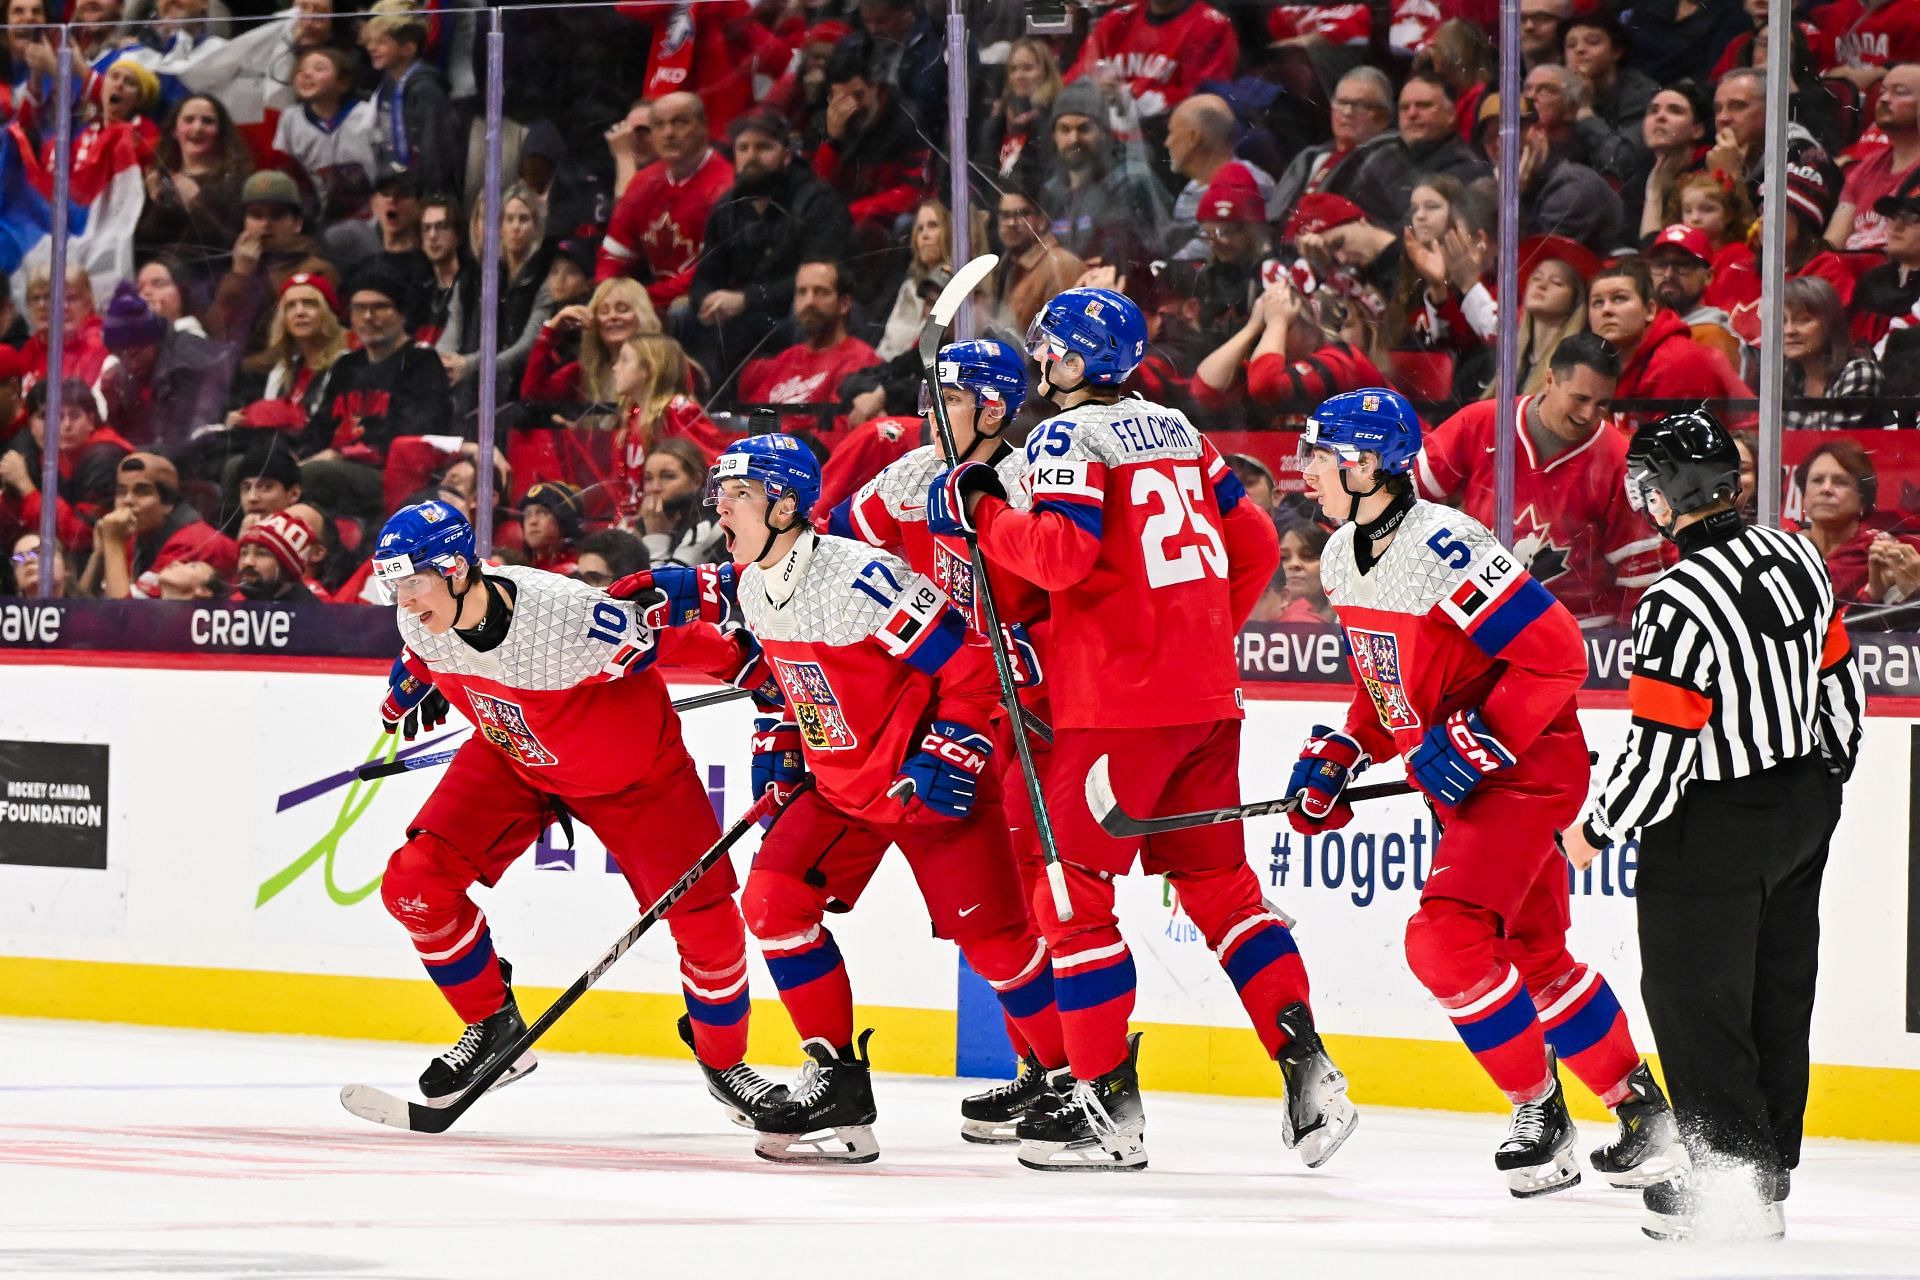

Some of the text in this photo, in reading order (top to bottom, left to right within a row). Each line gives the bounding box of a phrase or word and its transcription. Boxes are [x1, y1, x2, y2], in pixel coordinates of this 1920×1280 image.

[1072, 333, 1097, 349] CCM
[996, 374, 1018, 383] CCM
[1026, 420, 1078, 465] 25
[1110, 415, 1193, 453] FELCMAN
[1354, 432, 1383, 440] CCM
[789, 468, 810, 479] CCM
[1037, 467, 1075, 486] KB
[1130, 464, 1229, 590] 25
[1426, 527, 1471, 570] 5
[783, 550, 798, 582] CCM
[1479, 555, 1512, 588] KB
[851, 560, 904, 610] 17
[910, 587, 937, 615] KB
[1758, 565, 1804, 627] 11
[587, 601, 627, 646] 10
[1636, 624, 1657, 656] 11
[945, 726, 955, 736] 17
[921, 734, 986, 775] CCM
[7, 781, 91, 801] HOCKEY CANADA
[0, 800, 102, 828] FOUNDATION
[1212, 799, 1299, 824] CCM
[653, 863, 704, 920] CCM
[808, 1103, 837, 1120] BAUER
